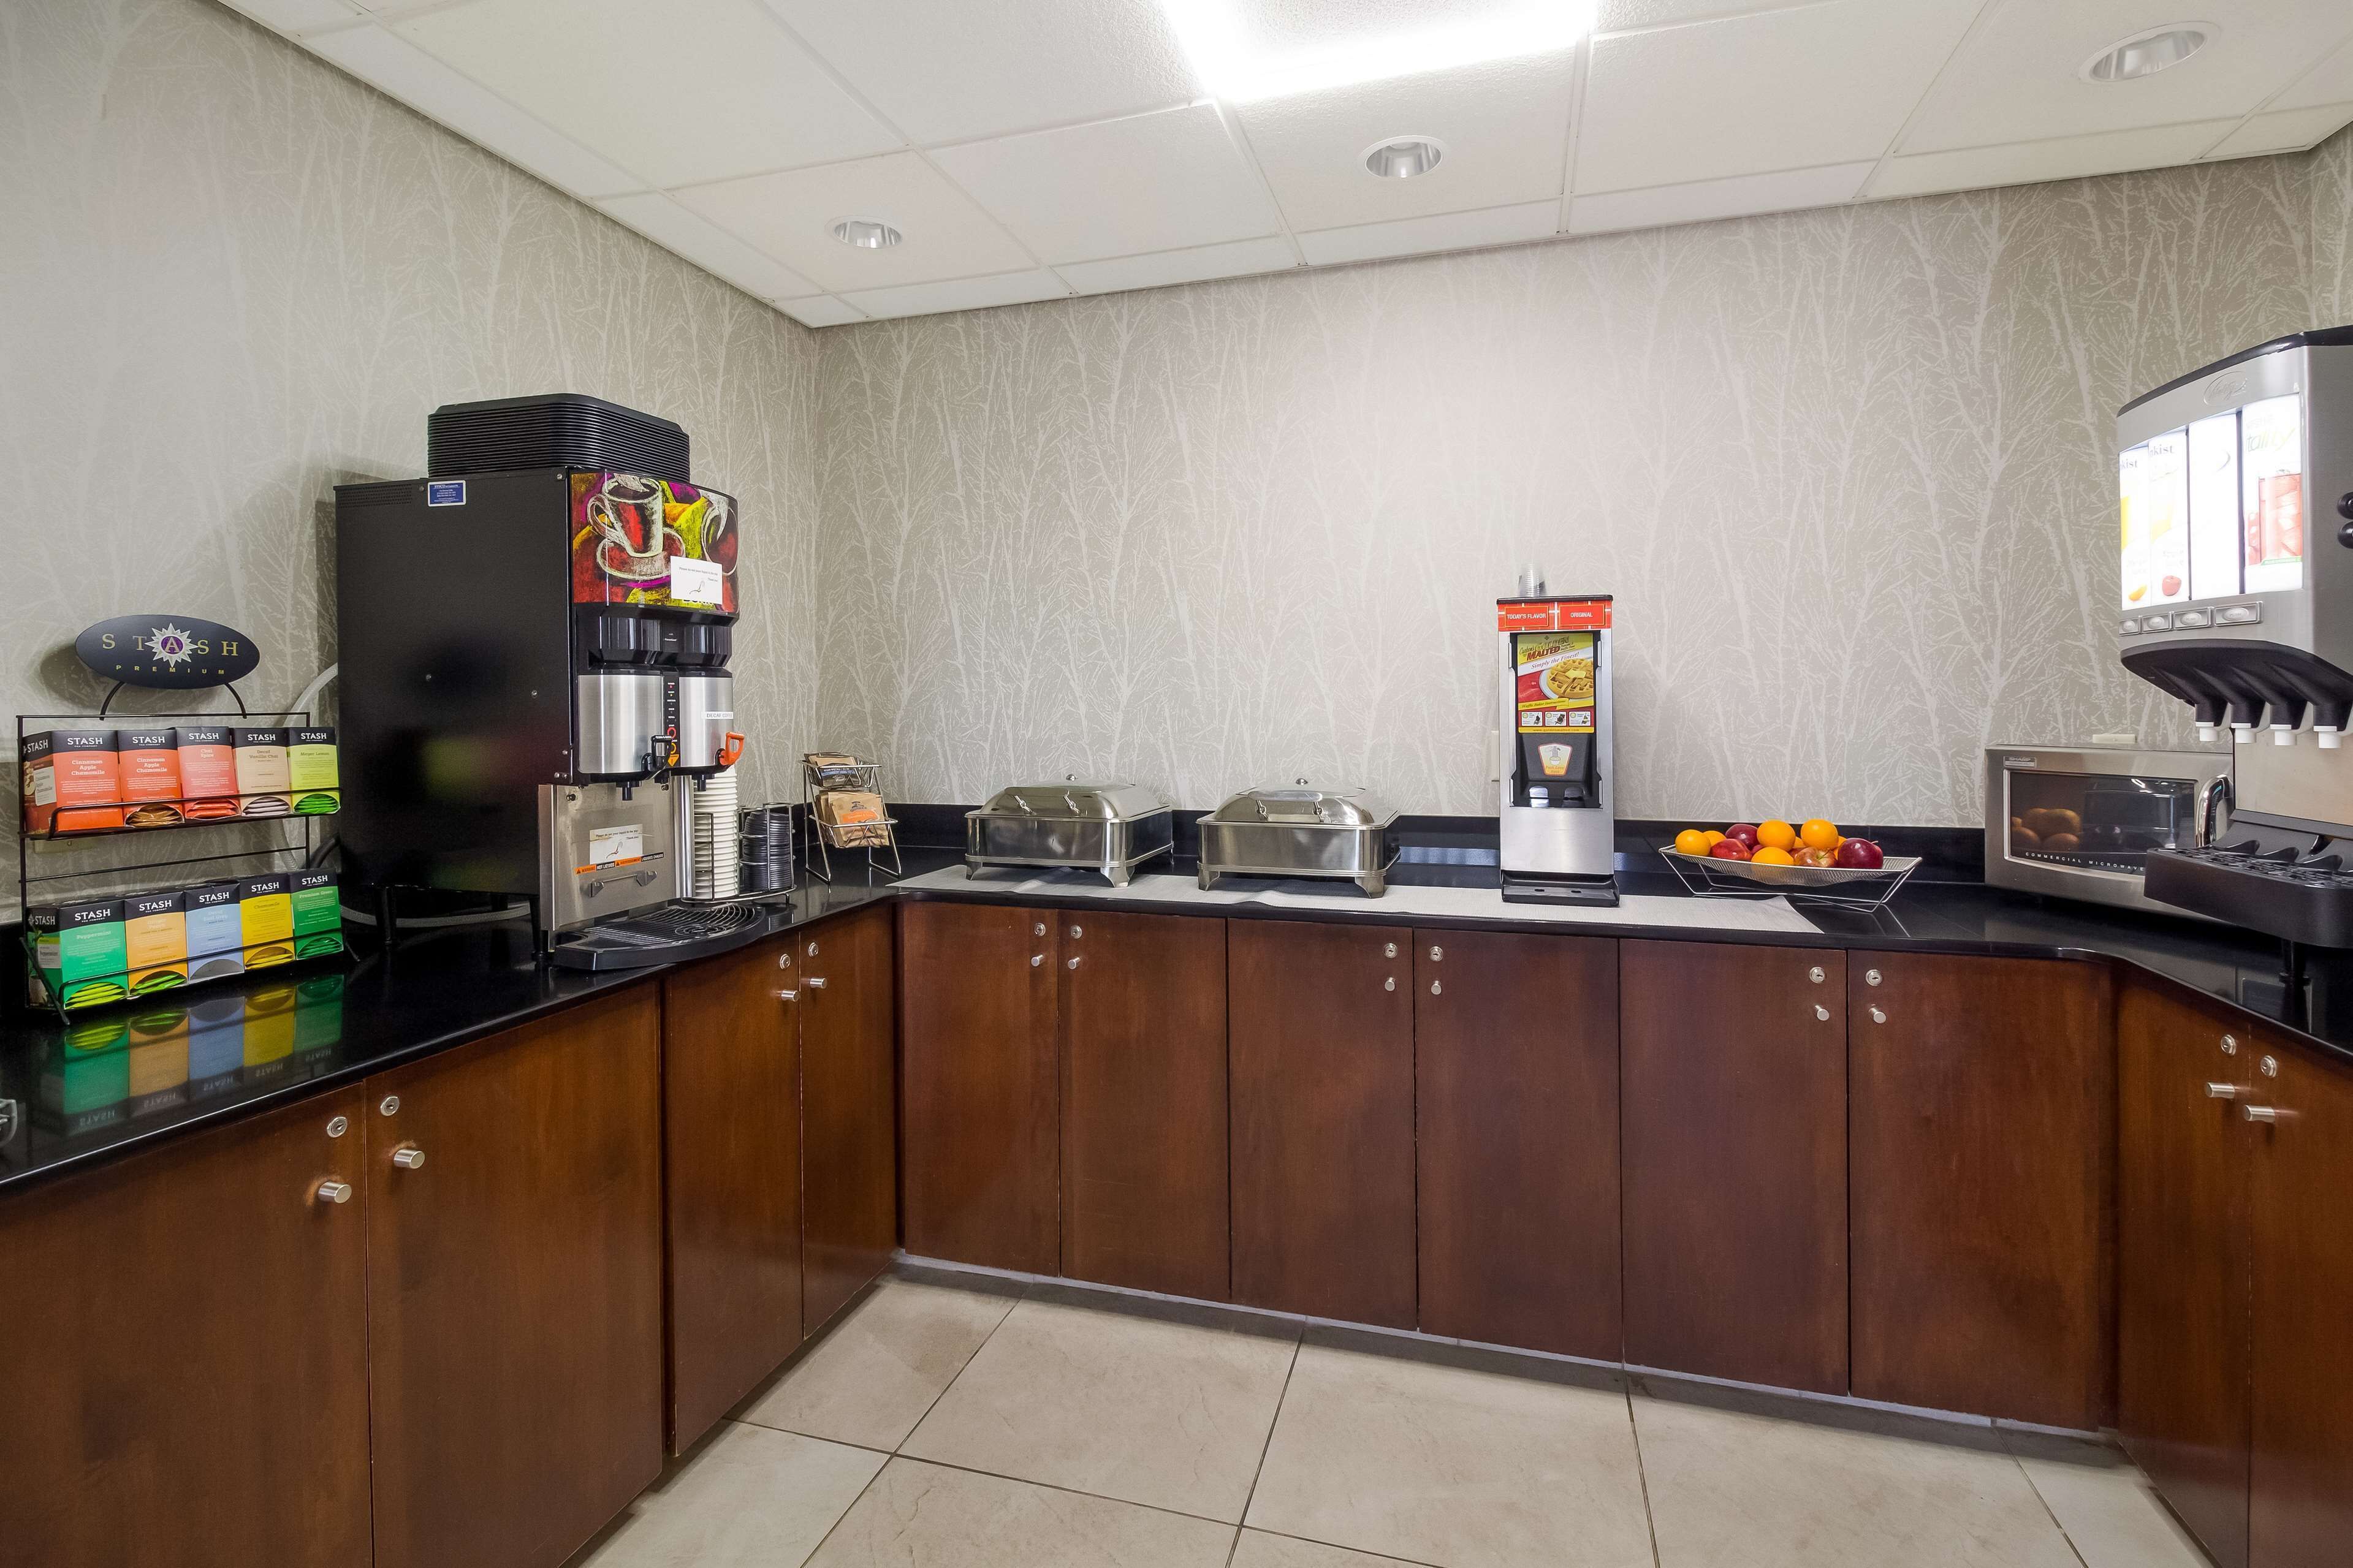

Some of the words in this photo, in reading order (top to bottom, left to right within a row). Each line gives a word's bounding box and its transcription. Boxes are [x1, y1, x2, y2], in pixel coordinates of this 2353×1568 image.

[102, 634, 238, 656] STASH
[1527, 645, 1560, 661] MALTED
[1531, 659, 1550, 670] Simply
[1560, 651, 1579, 662] Finest!
[116, 665, 225, 675] PREMIUM
[28, 739, 48, 753] STASH
[2025, 852, 2081, 863] COMMERCIAL
[2089, 860, 2145, 871] MICROWAVE
[302, 875, 328, 885] STASH
[251, 882, 279, 892] STASH
[199, 892, 230, 903] STASH
[139, 900, 172, 911] STASH
[35, 915, 56, 925] STASH
[75, 909, 111, 921] STASH
